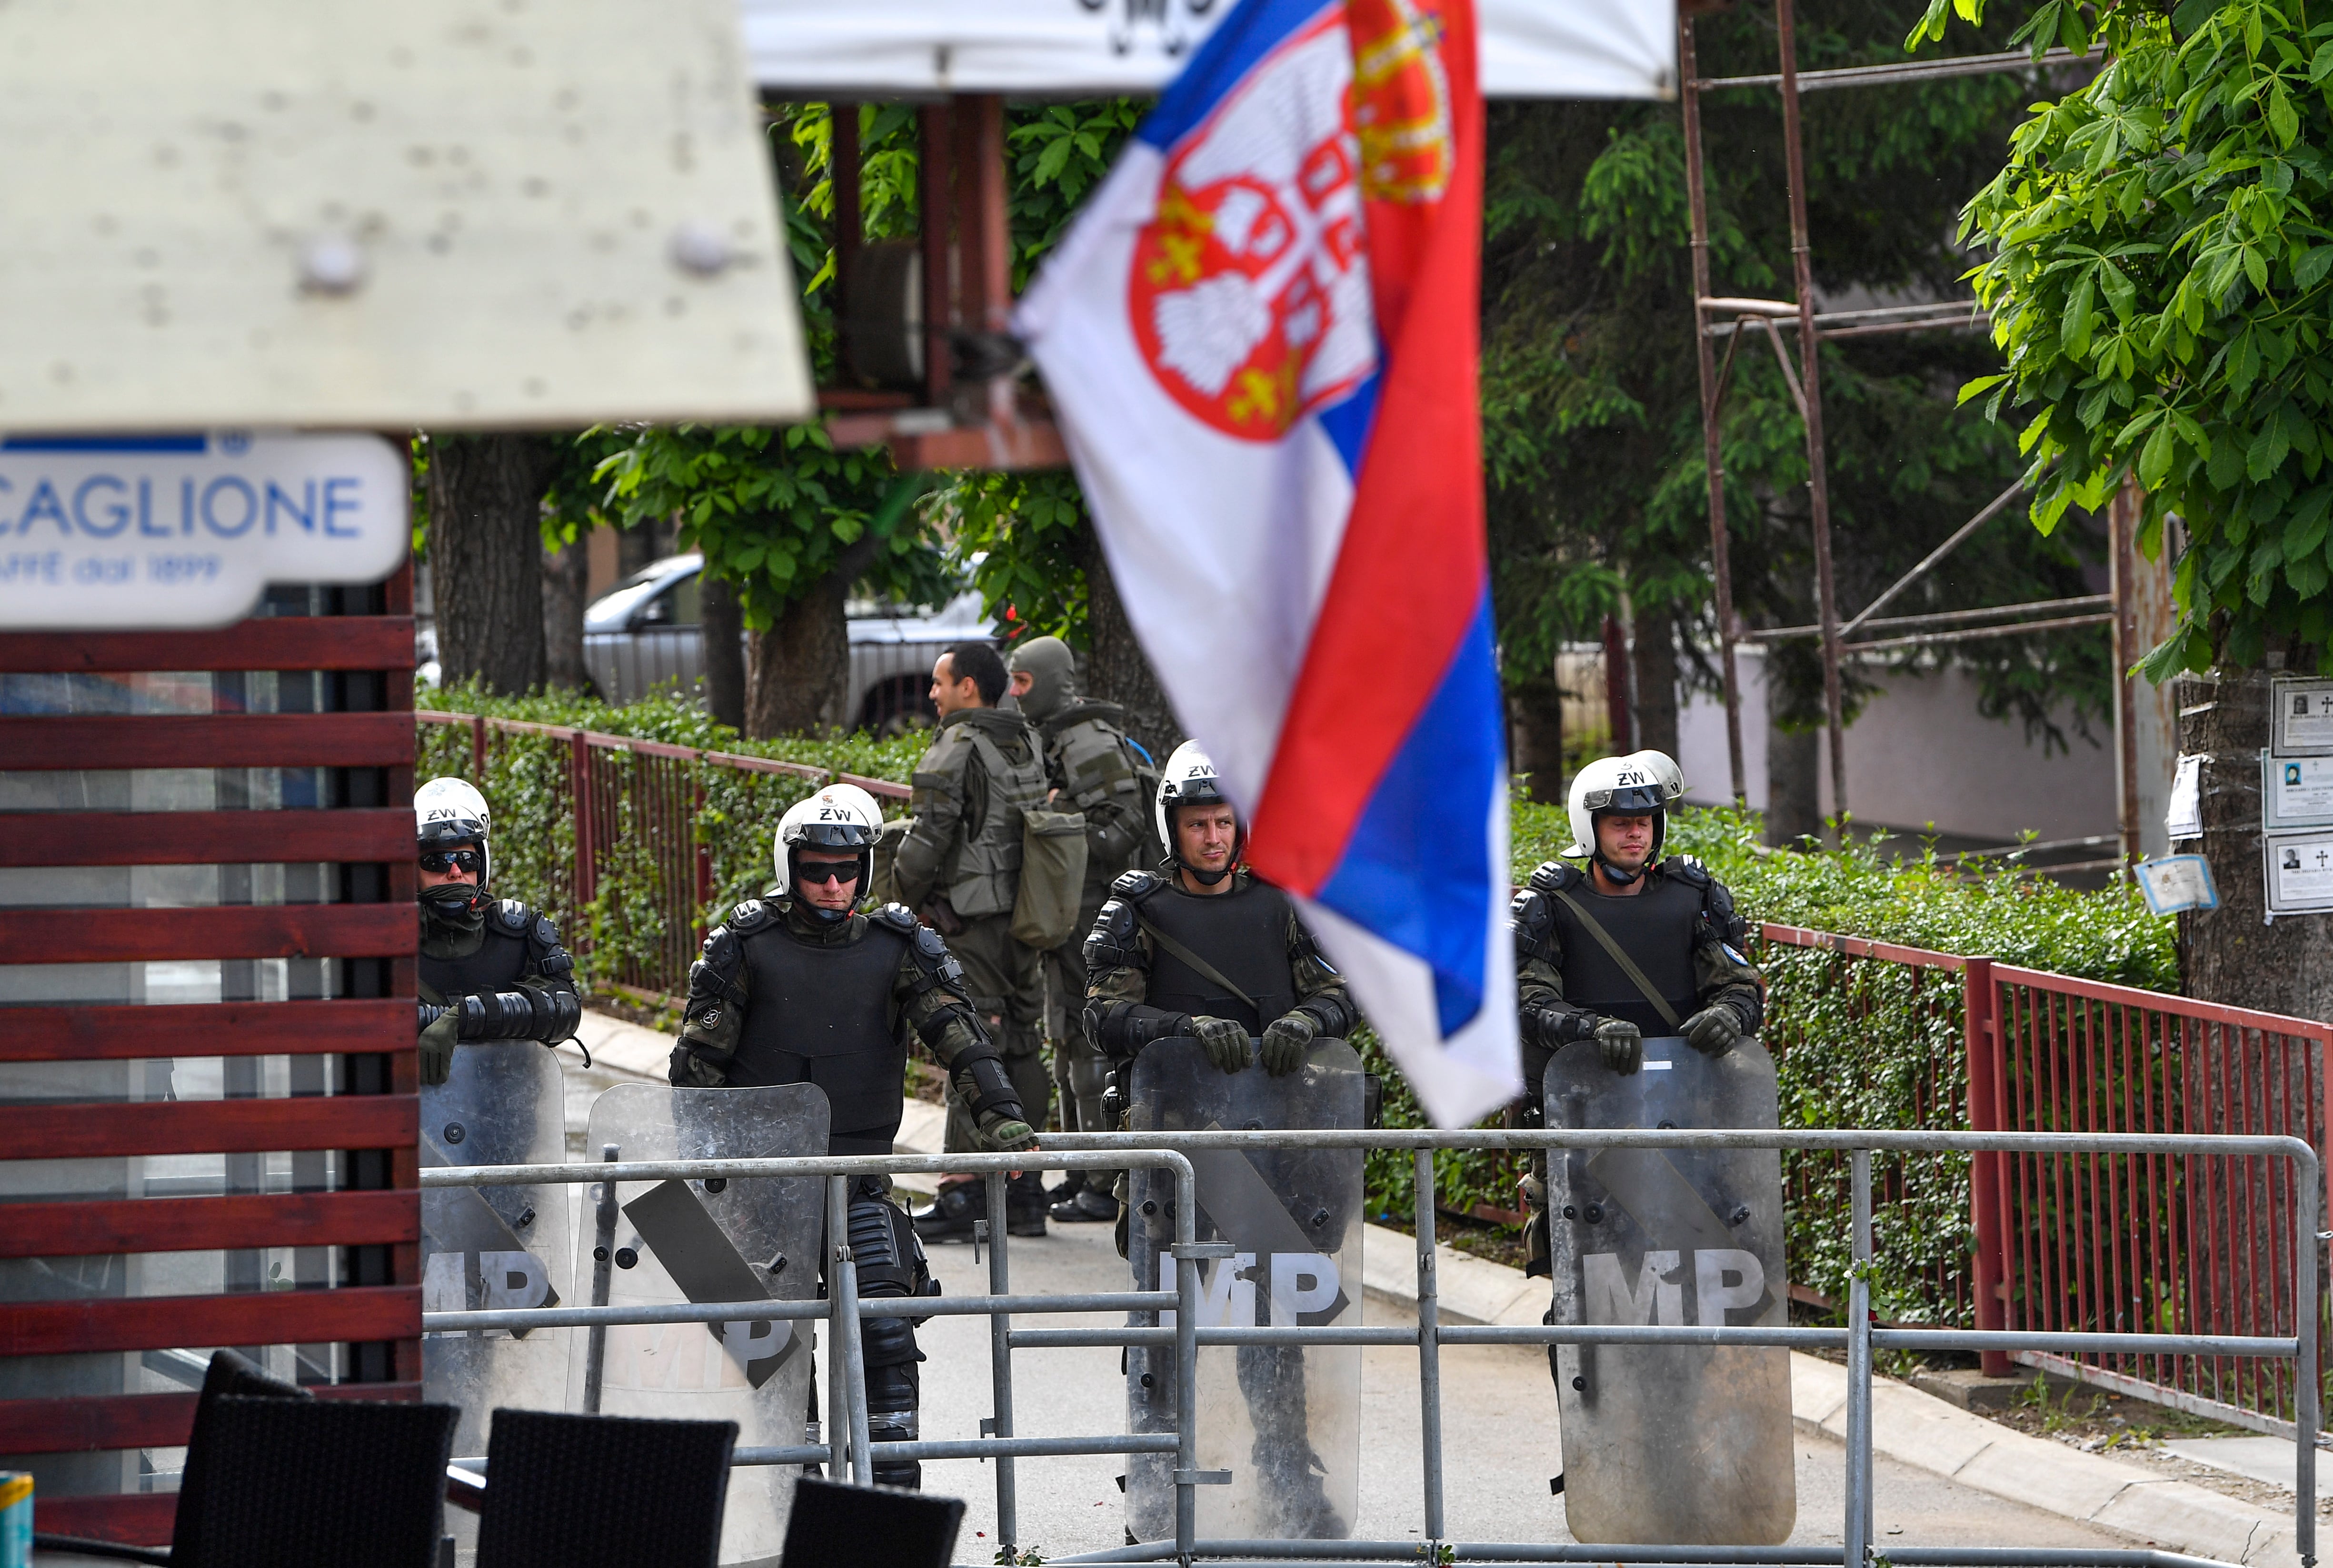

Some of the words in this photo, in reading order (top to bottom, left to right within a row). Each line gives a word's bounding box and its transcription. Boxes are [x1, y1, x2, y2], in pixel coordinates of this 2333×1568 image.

[0, 474, 363, 539] AGLIONE
[1159, 1251, 1340, 1327] MP
[1583, 1249, 1764, 1326] MP
